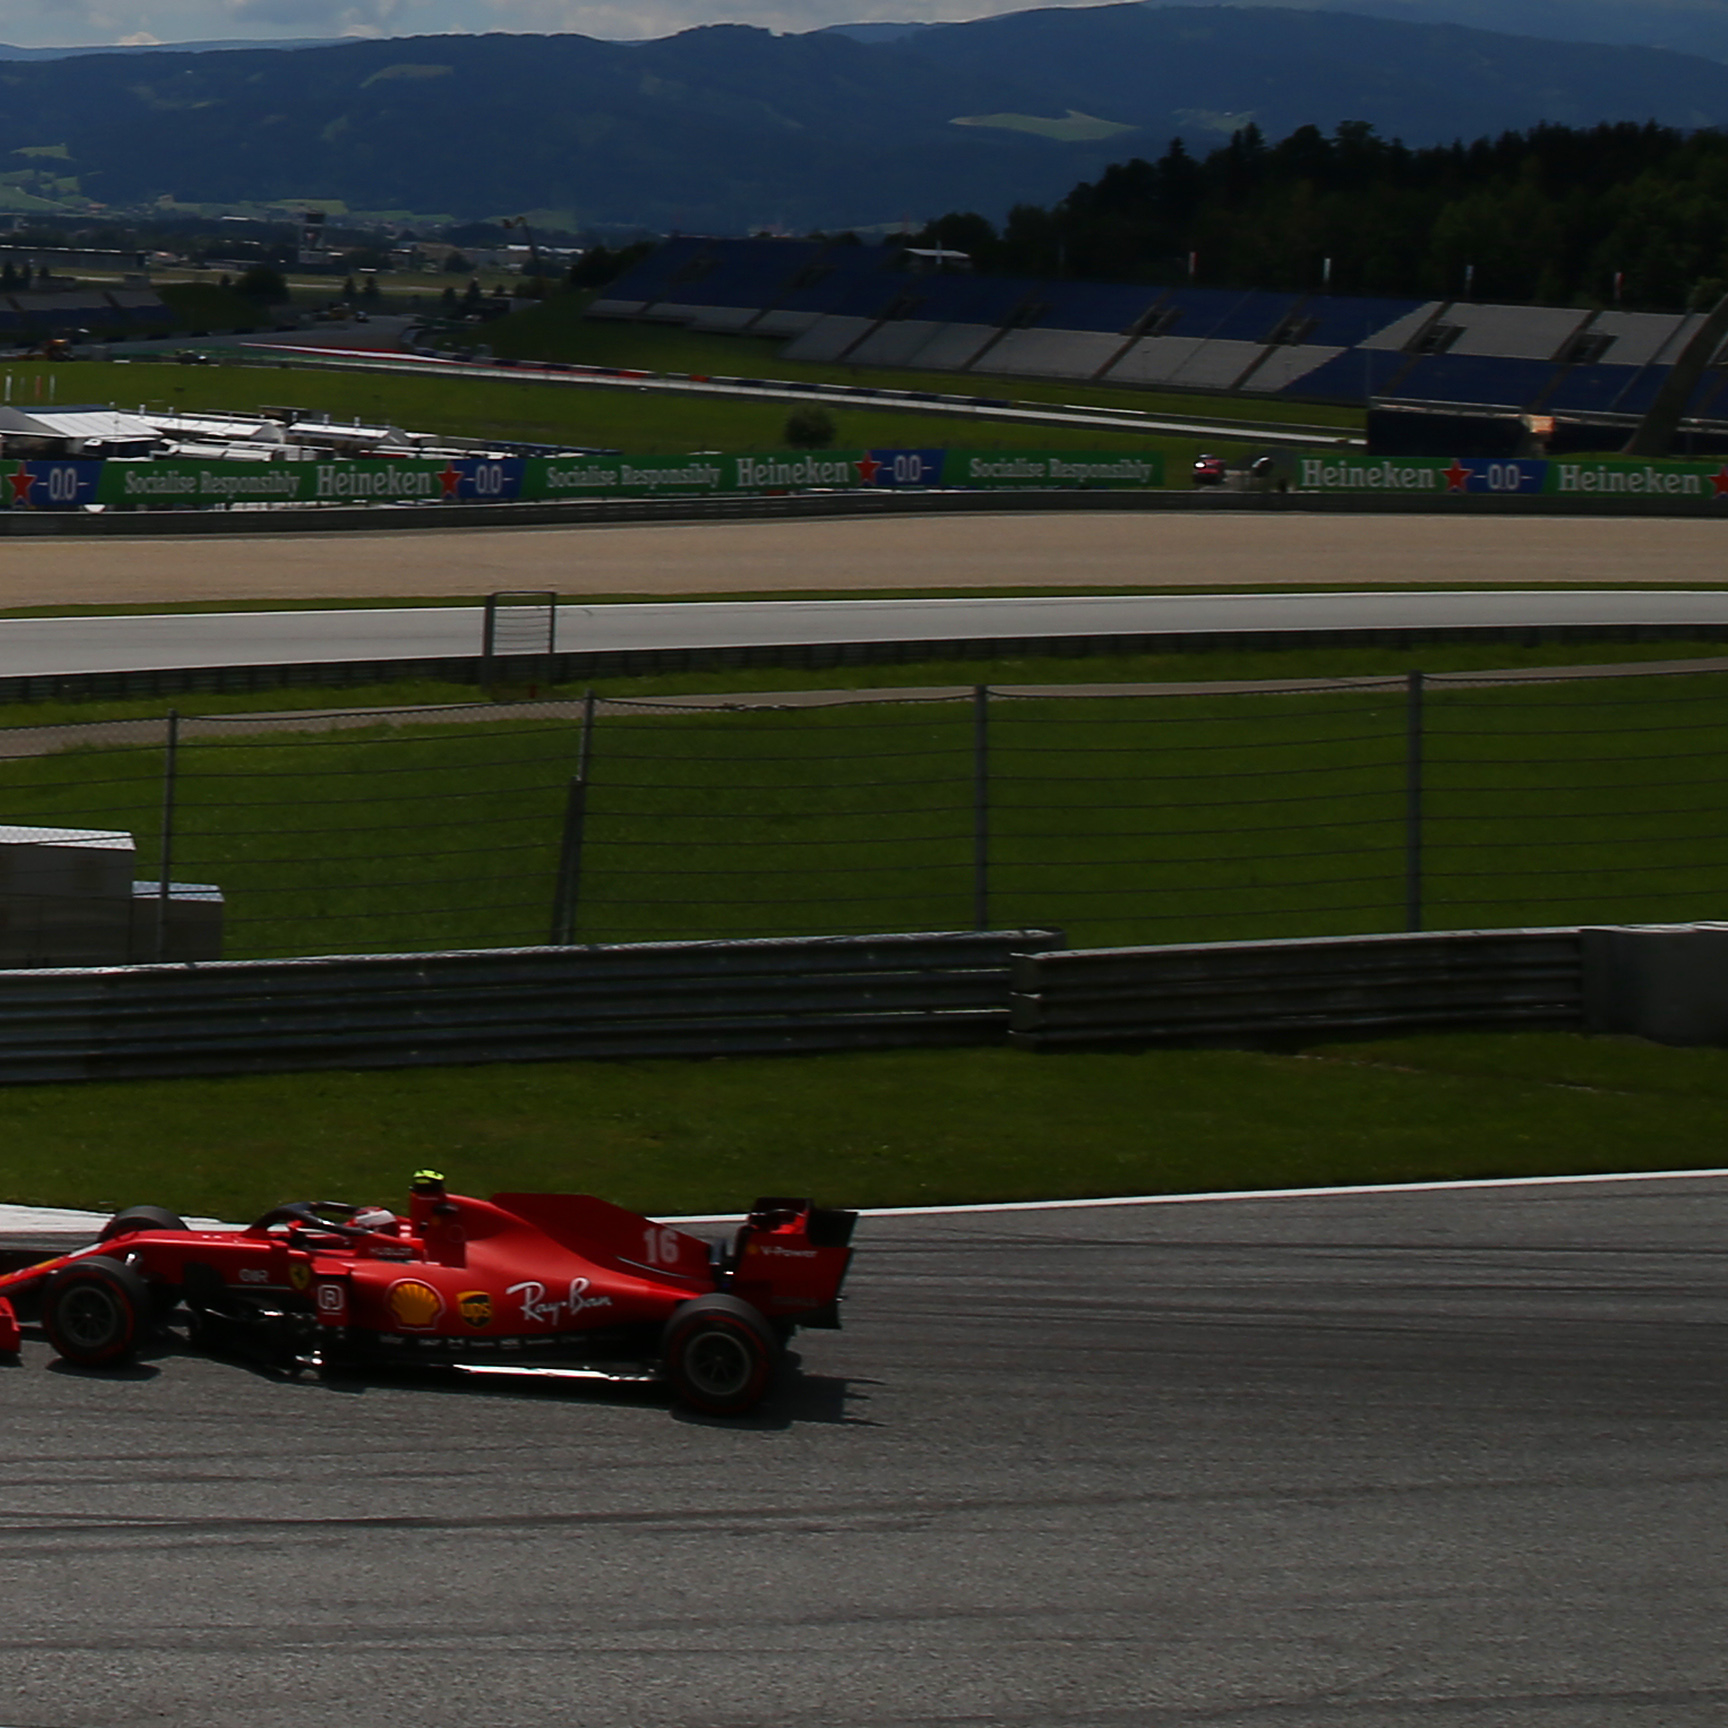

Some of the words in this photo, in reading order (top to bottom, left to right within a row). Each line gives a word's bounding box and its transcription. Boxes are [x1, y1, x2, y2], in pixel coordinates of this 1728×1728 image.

[124, 470, 197, 494] Socialise
[200, 470, 301, 499] Responsibly
[315, 464, 432, 496] Heineken
[546, 466, 616, 488] Socialise
[620, 463, 721, 489] Responsibly
[736, 456, 850, 487] Heineken
[969, 458, 1045, 478] Socialise
[1049, 458, 1153, 483] Responsibly
[1301, 459, 1436, 489] Heineken
[1557, 465, 1702, 493] Heineken
[642, 1227, 680, 1265] 16
[505, 1277, 613, 1326] Ray-Ban
